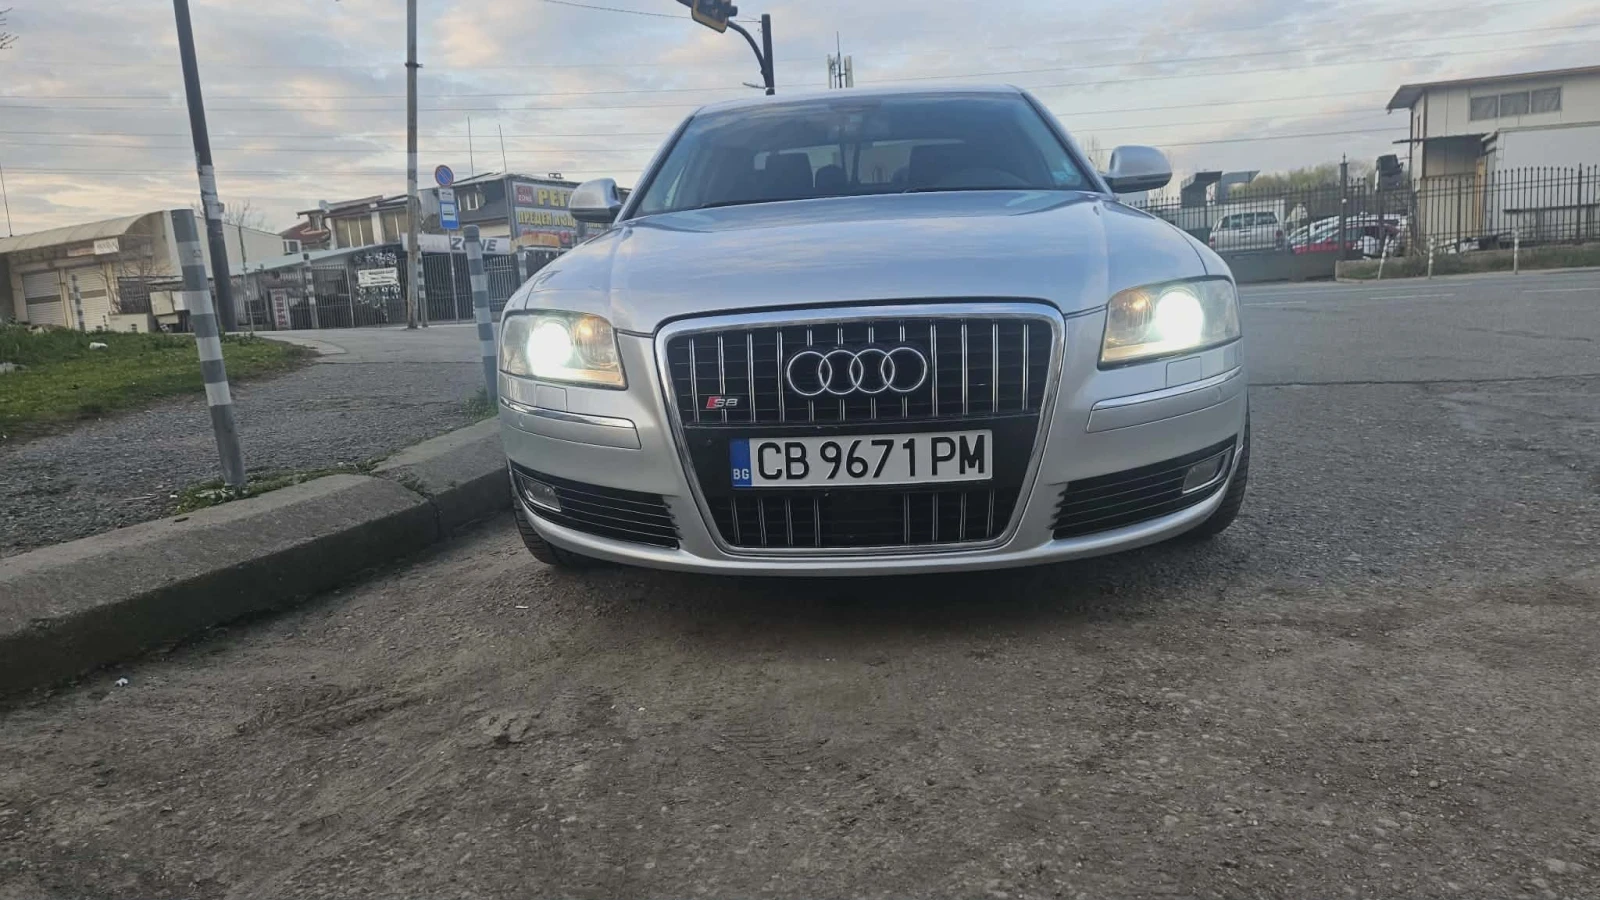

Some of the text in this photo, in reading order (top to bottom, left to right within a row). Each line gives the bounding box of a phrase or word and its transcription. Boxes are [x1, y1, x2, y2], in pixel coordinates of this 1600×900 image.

[537, 187, 573, 208] РЕГ
[451, 237, 498, 252] ZNE
[713, 397, 738, 408] S8
[732, 434, 986, 481] BG CB 9671 PM
